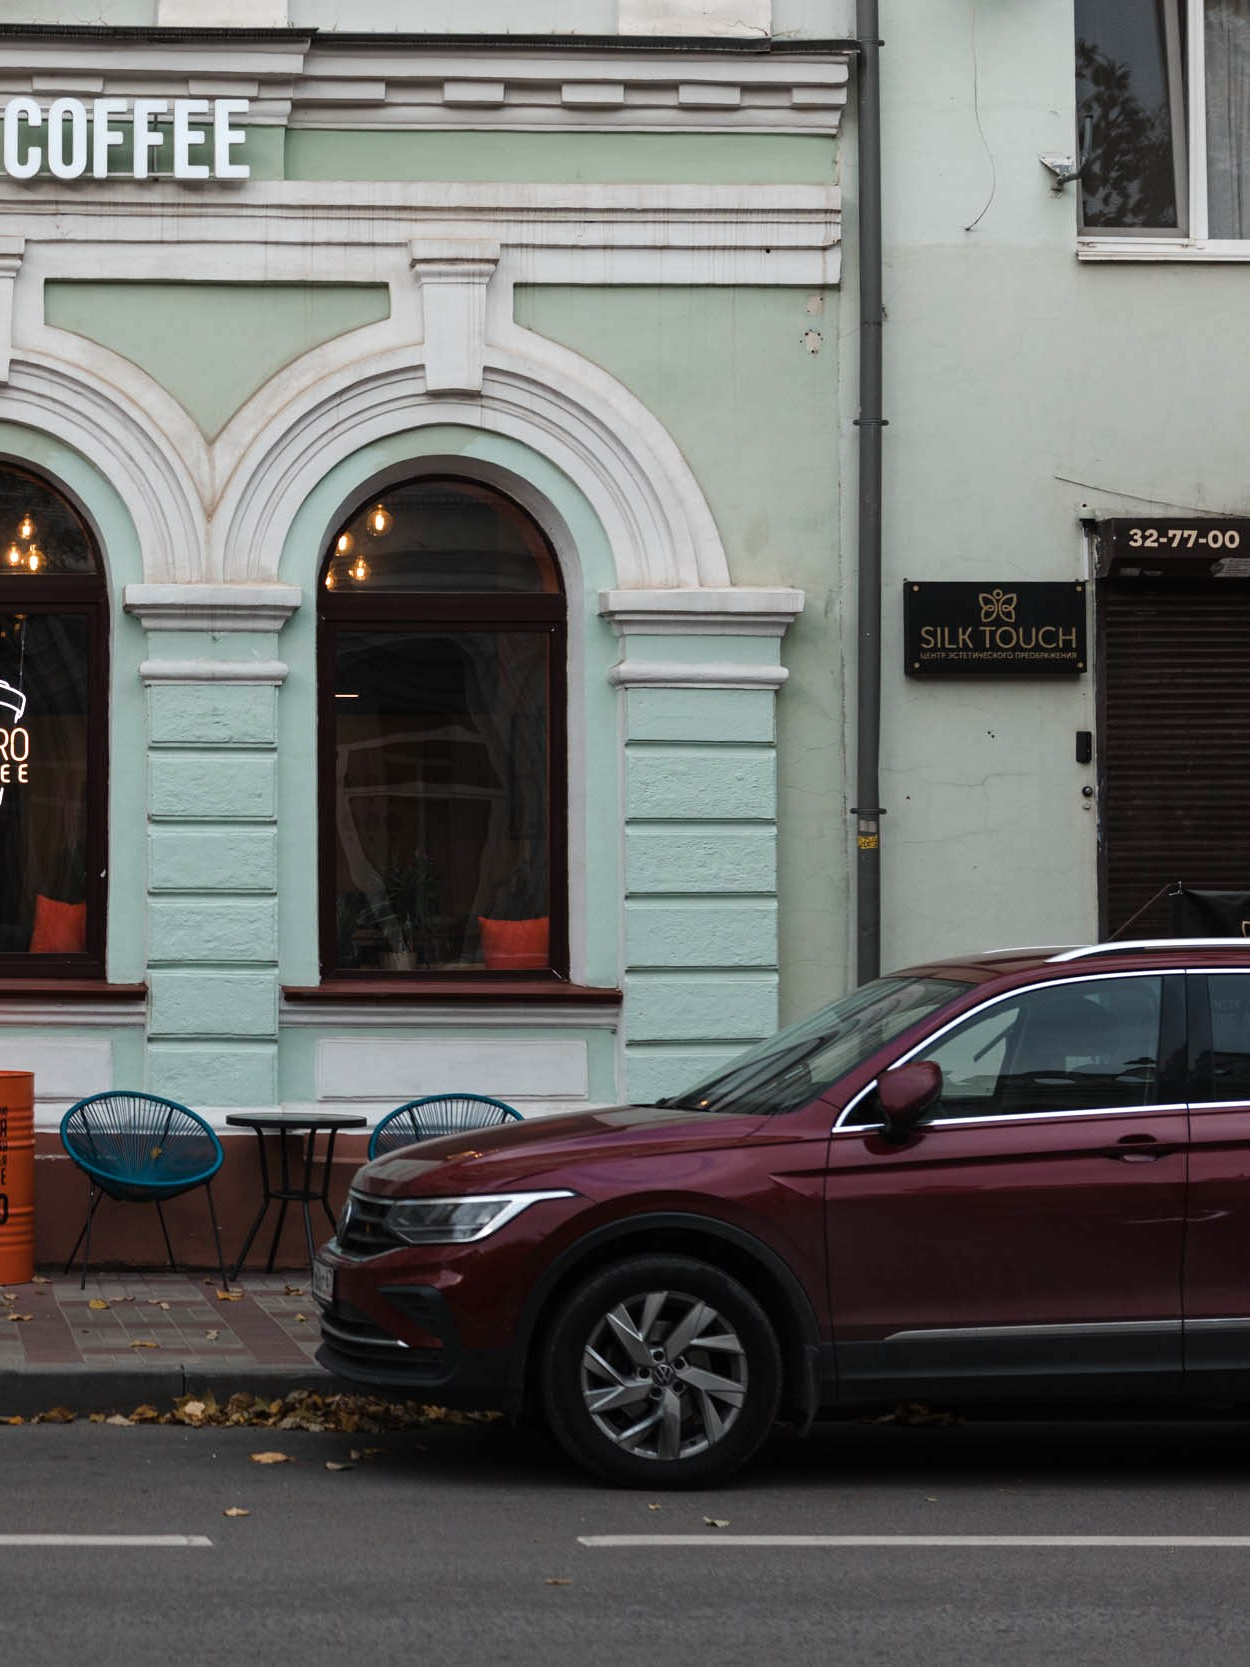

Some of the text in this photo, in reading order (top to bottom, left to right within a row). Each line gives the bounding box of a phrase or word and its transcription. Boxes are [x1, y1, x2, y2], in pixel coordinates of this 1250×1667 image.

[4, 97, 250, 180] COFFEE
[1128, 528, 1240, 548] 32-77-00
[920, 626, 1077, 648] SILK TOUCH
